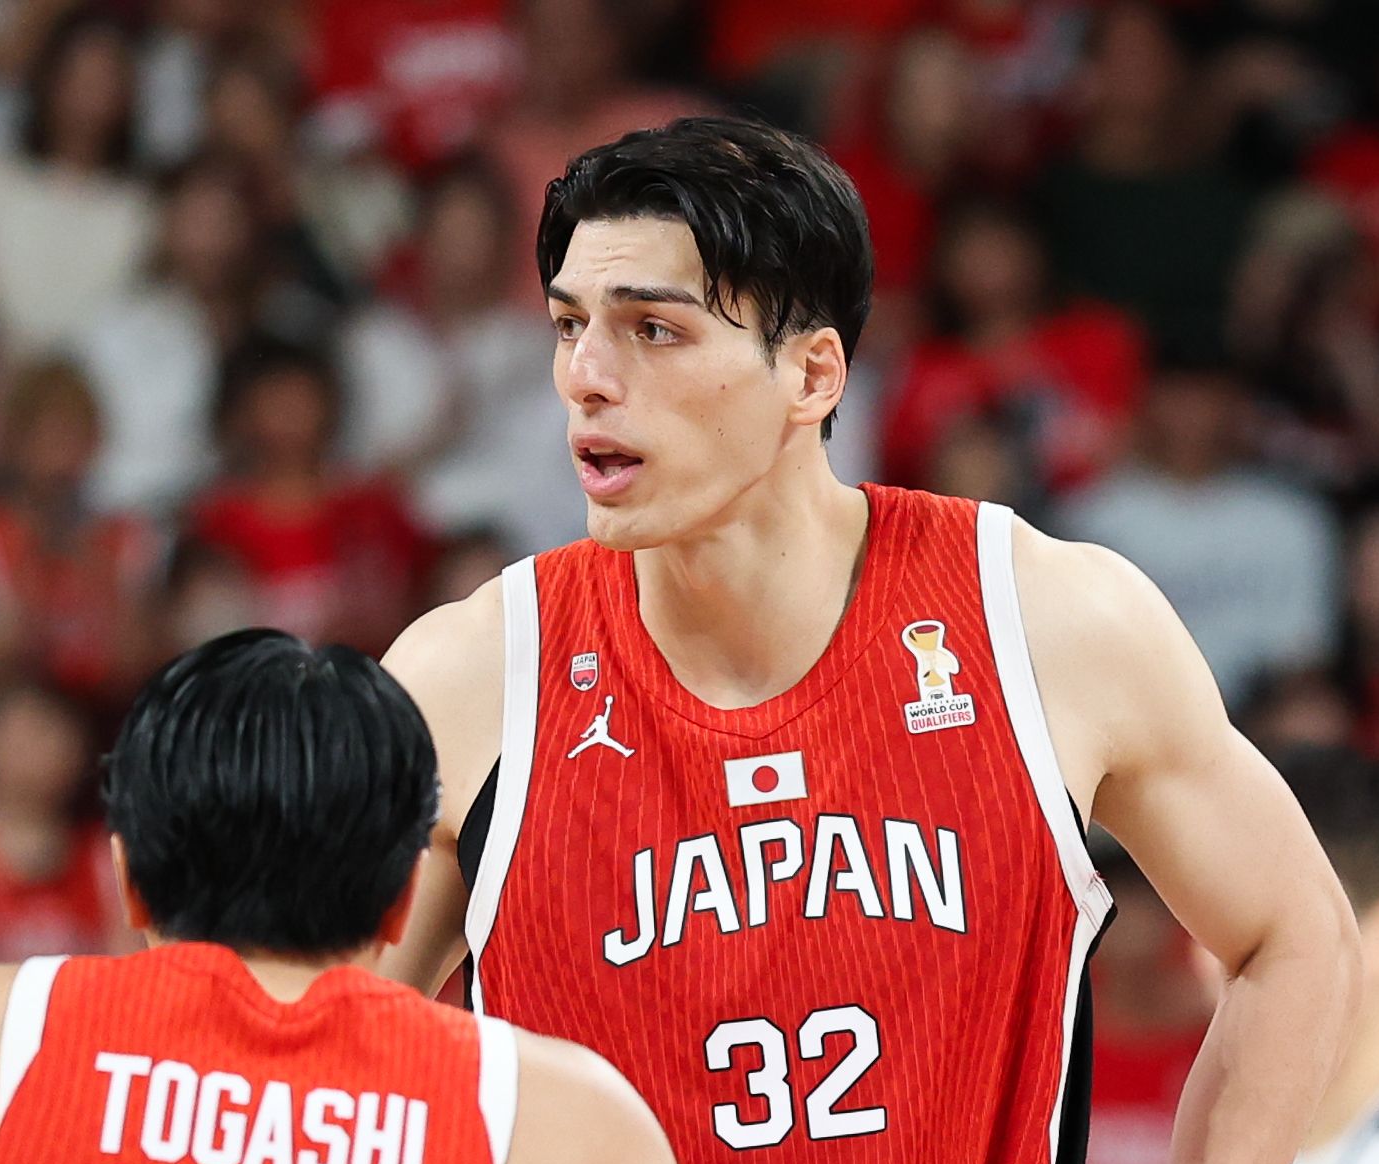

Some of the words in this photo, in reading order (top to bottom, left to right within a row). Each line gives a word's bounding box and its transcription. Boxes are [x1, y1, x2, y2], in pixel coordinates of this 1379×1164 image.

[909, 705, 947, 718] WORLD
[949, 702, 969, 712] CUP
[911, 710, 972, 731] QUALIFIERS
[602, 813, 968, 967] JAPAN
[703, 1003, 887, 1151] 32
